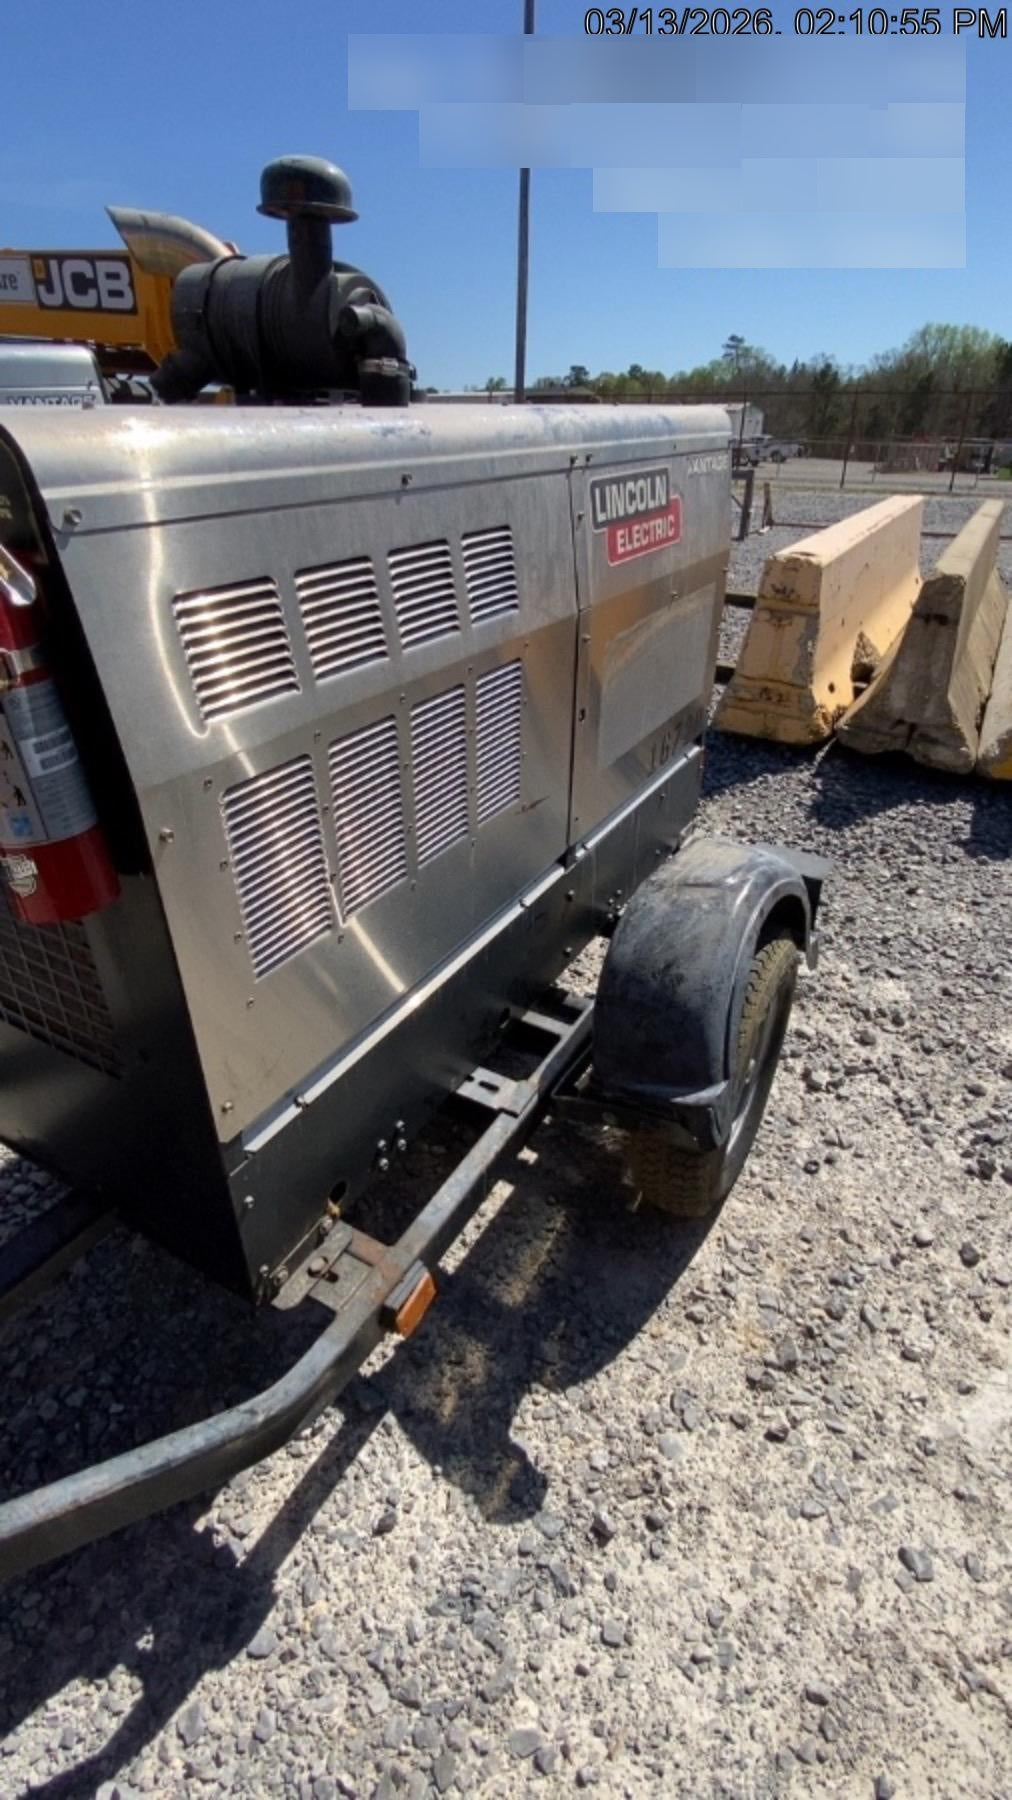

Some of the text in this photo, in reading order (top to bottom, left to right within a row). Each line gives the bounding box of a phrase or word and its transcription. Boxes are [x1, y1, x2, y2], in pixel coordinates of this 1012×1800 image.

[37, 258, 135, 310] JCB
[594, 474, 668, 523] LINCOLN
[616, 514, 675, 555] ELECTRIC
